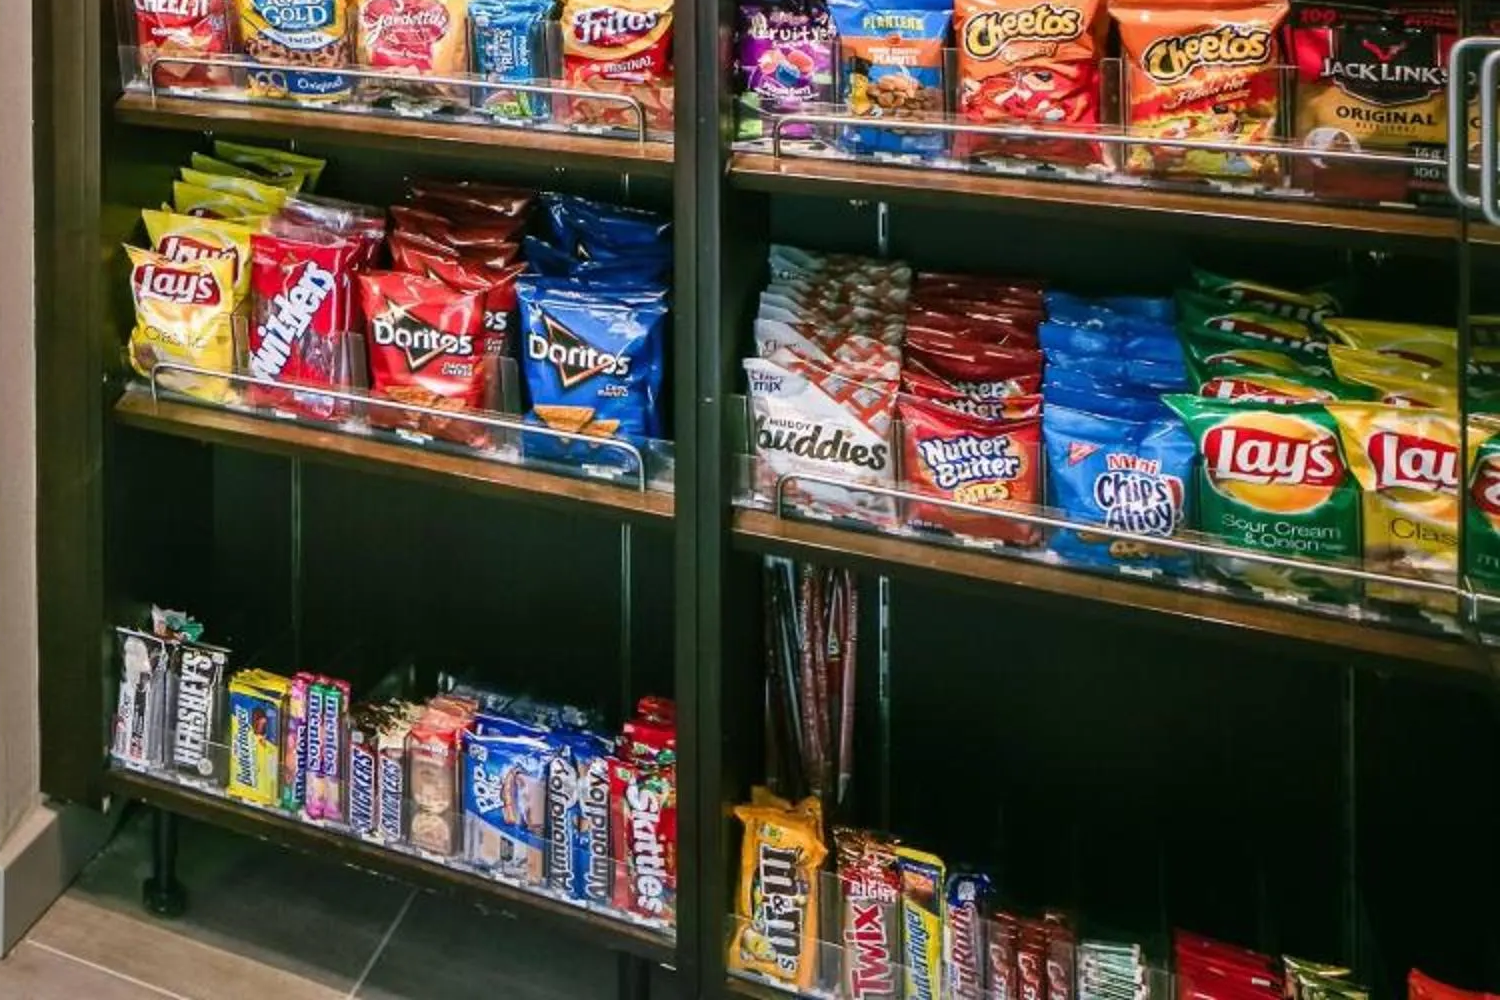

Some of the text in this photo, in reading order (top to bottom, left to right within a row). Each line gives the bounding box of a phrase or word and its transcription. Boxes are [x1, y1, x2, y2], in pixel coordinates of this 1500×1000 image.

[261, 4, 327, 26] GOLD
[574, 7, 661, 44] Fritos
[964, 3, 1086, 61] Cheetos
[1144, 24, 1271, 85] Cheetos
[1320, 58, 1379, 84] JACK
[1335, 105, 1437, 127] ORIGINAL
[140, 267, 215, 306] Lay's
[373, 319, 473, 355] Doritos
[528, 334, 631, 375] Doritos
[919, 435, 1011, 464] Nutter
[1215, 429, 1336, 485] Lay's
[936, 457, 1022, 489] Butter
[1096, 472, 1168, 508] Chips
[1221, 514, 1341, 539] Sour Cream
[1258, 532, 1321, 551] Onion
[352, 751, 375, 833] SNICKERS
[625, 776, 666, 914] Skittles
